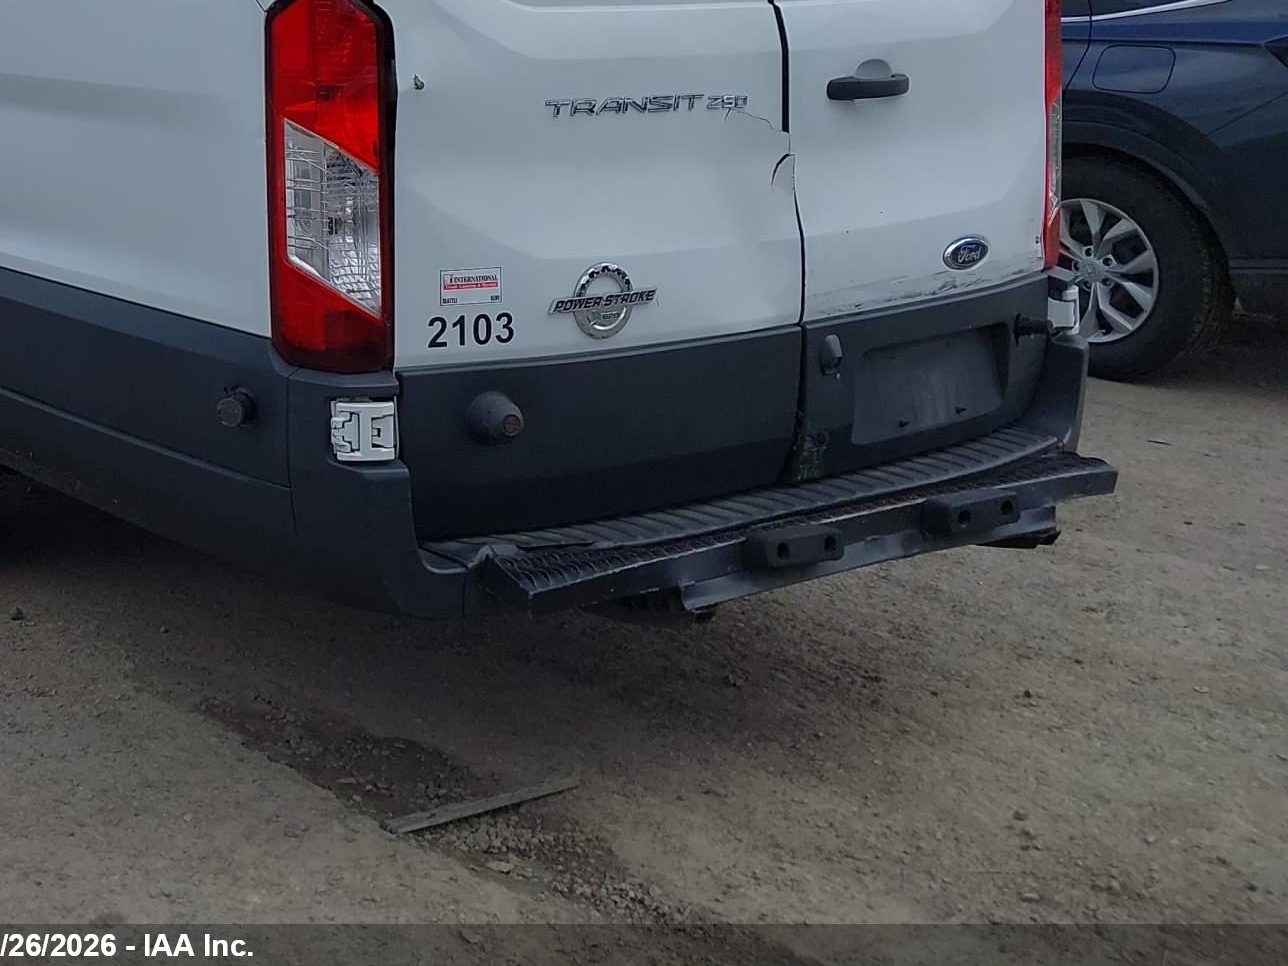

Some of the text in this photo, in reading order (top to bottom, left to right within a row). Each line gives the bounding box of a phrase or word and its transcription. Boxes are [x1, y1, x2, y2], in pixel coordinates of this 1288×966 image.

[545, 94, 705, 118] TRANSIT
[957, 244, 983, 263] Ford
[553, 289, 657, 312] POWER STROKE
[427, 312, 515, 349] 2103
